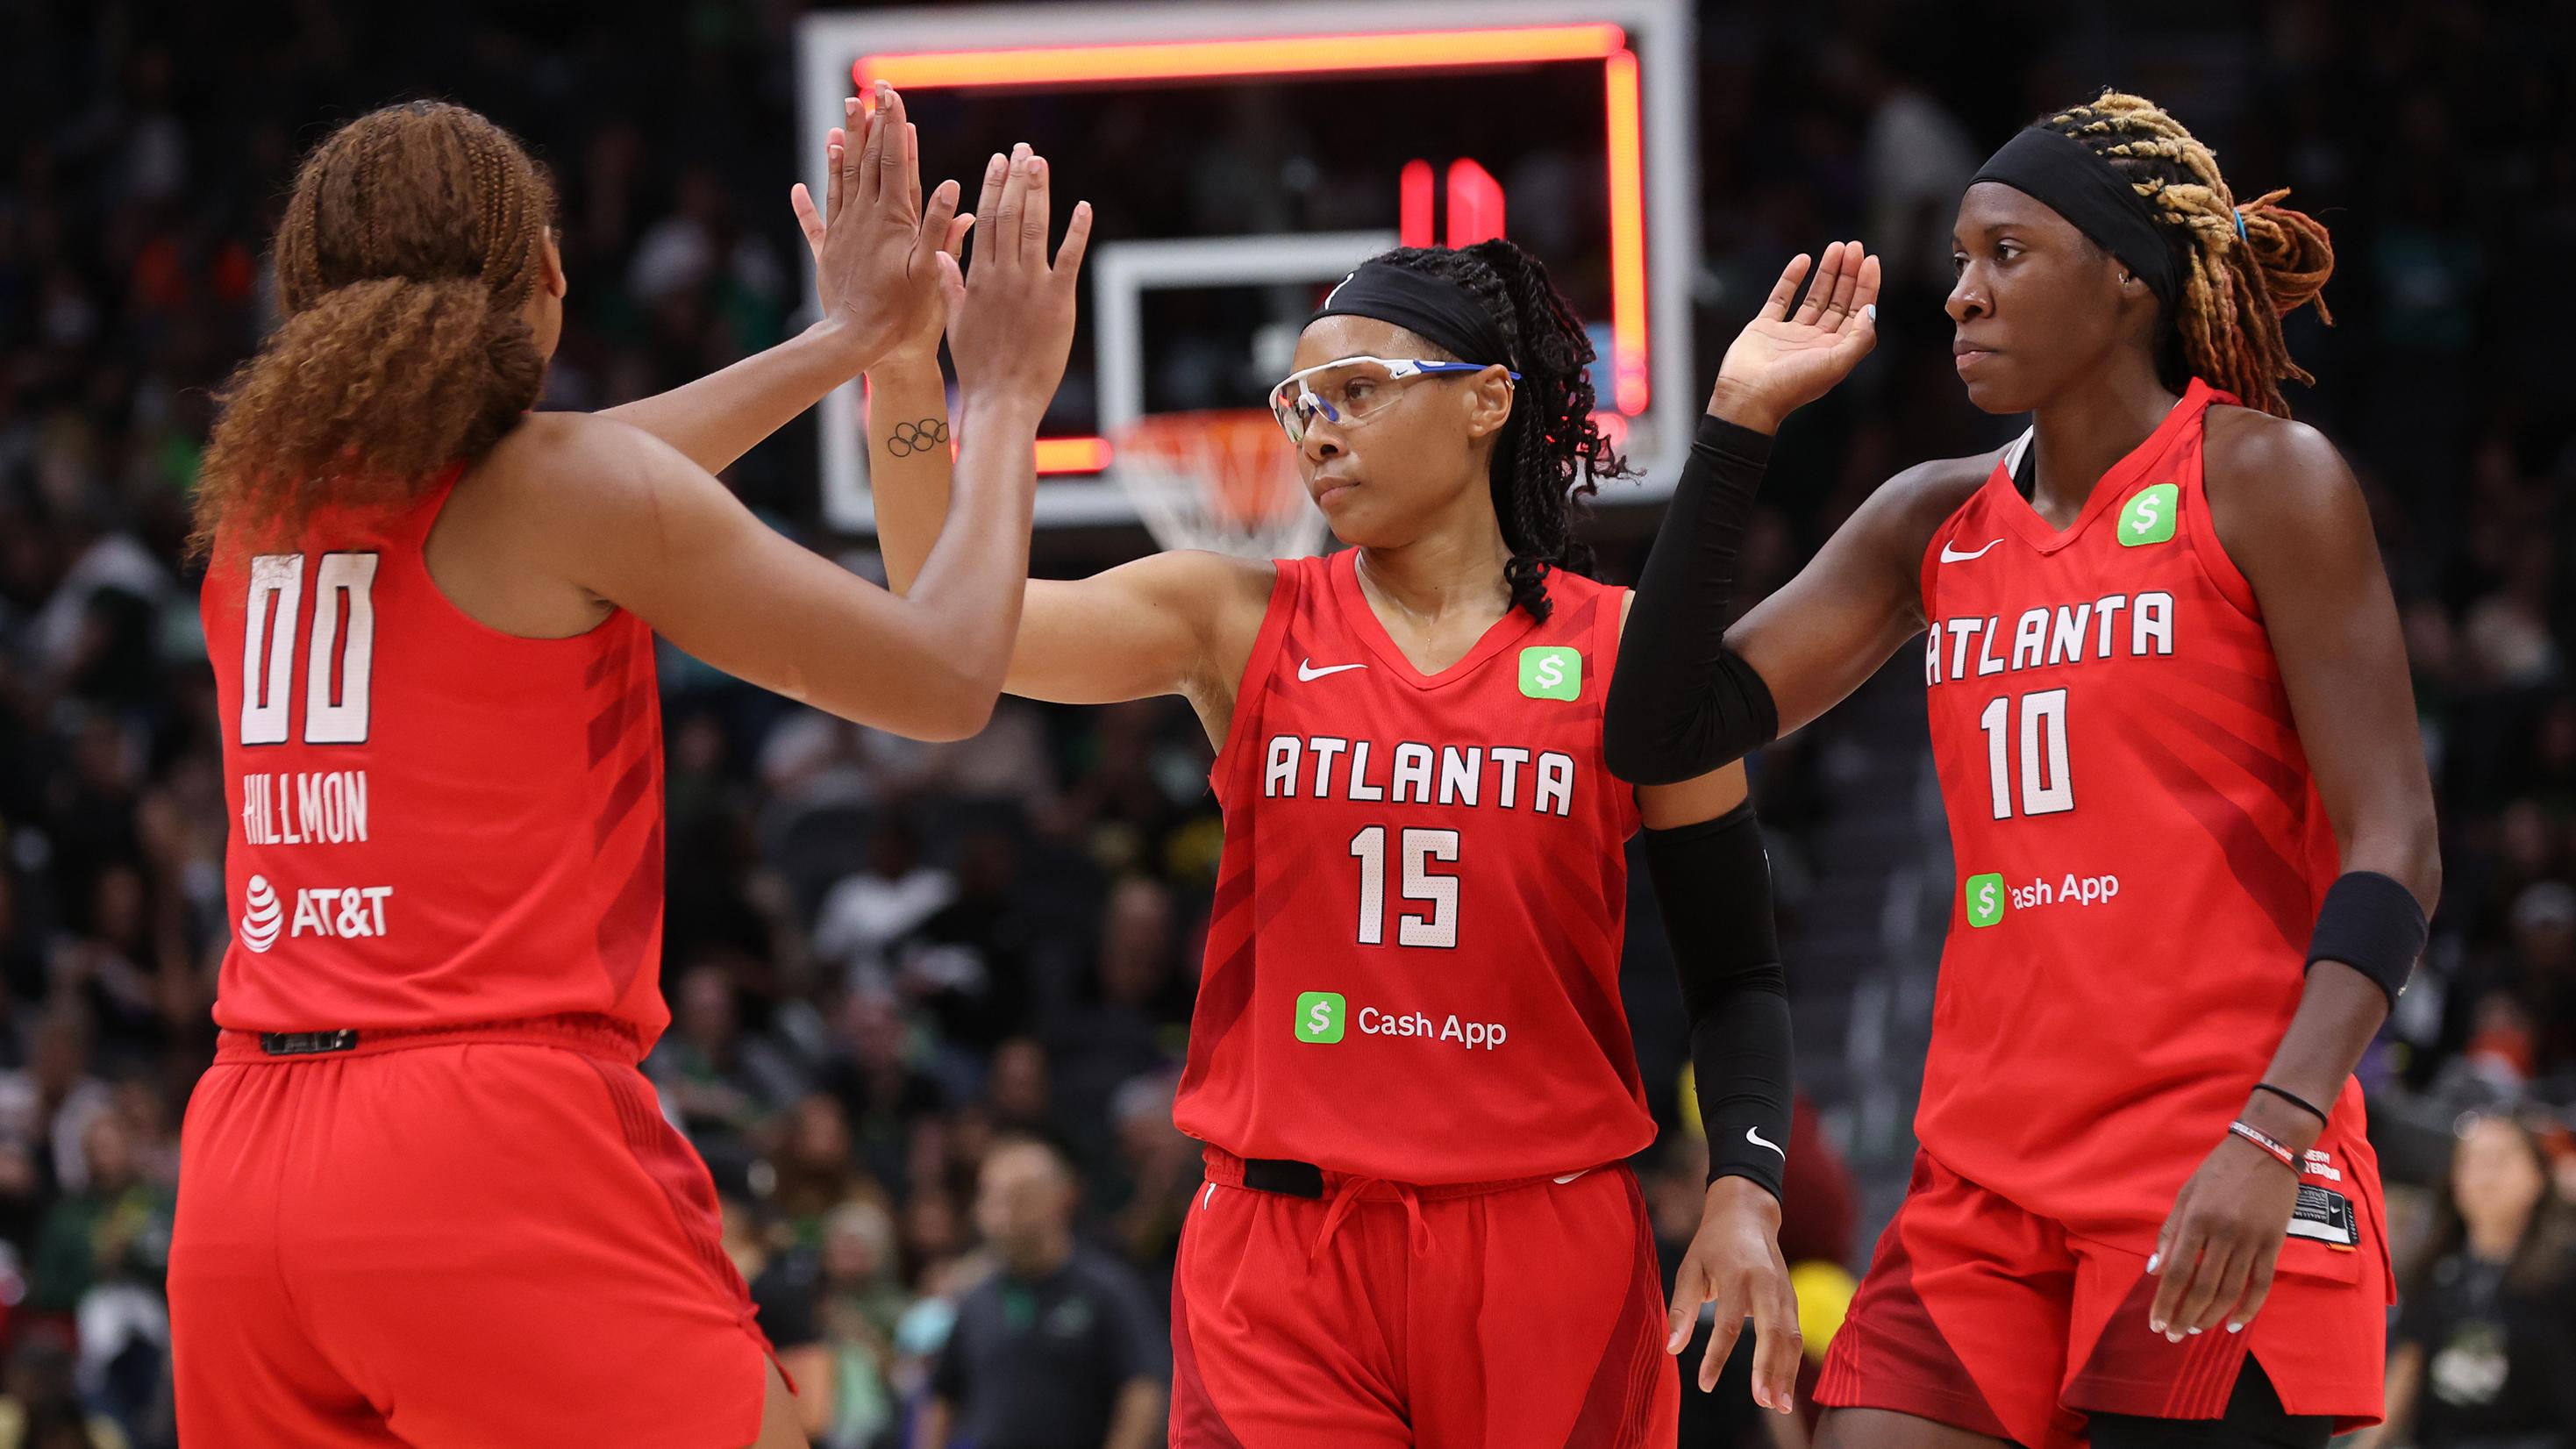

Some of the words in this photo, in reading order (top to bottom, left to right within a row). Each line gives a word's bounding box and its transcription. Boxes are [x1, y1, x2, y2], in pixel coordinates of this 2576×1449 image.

[239, 553, 378, 746] 00
[1925, 591, 2173, 687] ATLANTA
[1264, 735, 1575, 817] ATLANTA
[1980, 688, 2075, 821] 10
[241, 770, 368, 846] HILLMON
[291, 886, 394, 939] AT&T
[1350, 825, 1459, 948] 15
[2007, 877, 2052, 910] ash
[2058, 874, 2119, 906] App
[1358, 1007, 1433, 1039] Cash
[1440, 1015, 1507, 1051] App
